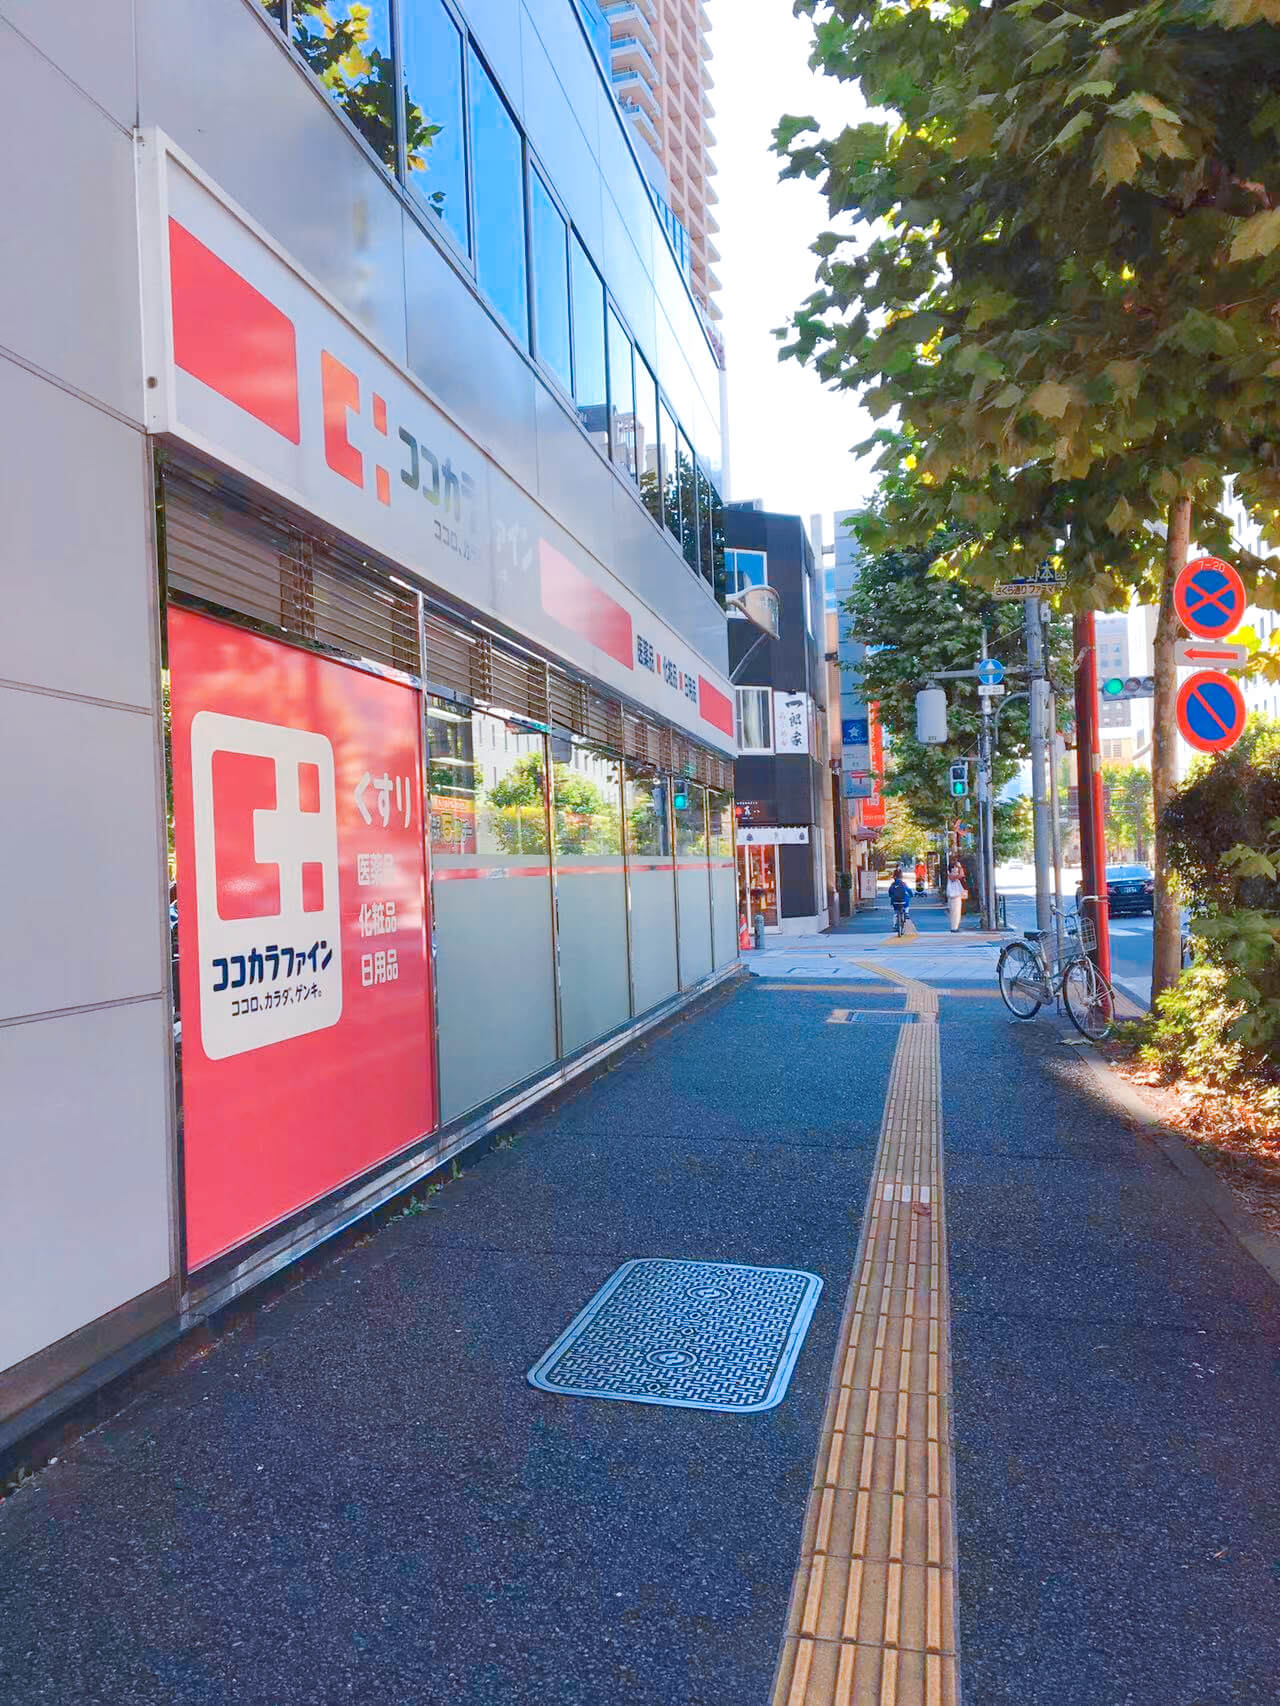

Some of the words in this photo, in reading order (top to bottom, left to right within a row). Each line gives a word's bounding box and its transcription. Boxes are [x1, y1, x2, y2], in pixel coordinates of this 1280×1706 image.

[354, 771, 411, 829] くすり
[358, 901, 398, 938] 化粧品
[211, 940, 333, 993] ココカラファイン
[361, 949, 399, 987] 日用品
